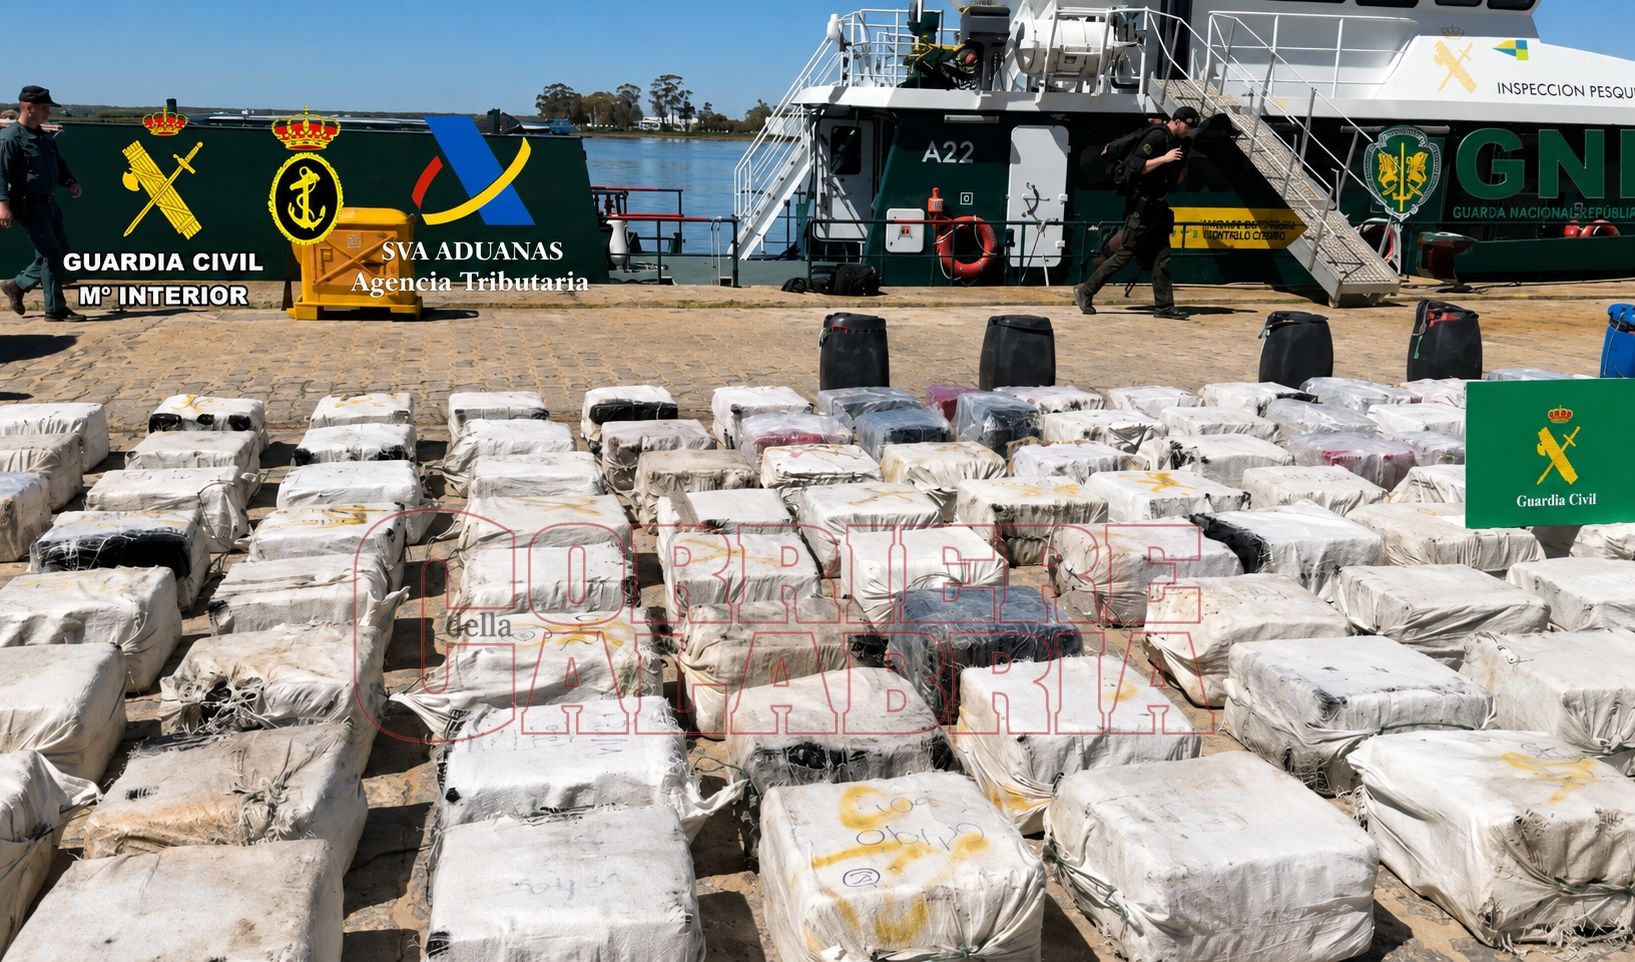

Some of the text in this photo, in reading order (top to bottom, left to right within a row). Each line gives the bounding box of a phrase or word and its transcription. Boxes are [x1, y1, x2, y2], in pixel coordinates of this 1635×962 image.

[1497, 82, 1585, 97] INSPECCION
[921, 140, 974, 164] A22
[1452, 206, 1506, 219] GUARDA
[1509, 206, 1574, 219] NACIONAL
[1516, 493, 1597, 508] Guardia Civil
